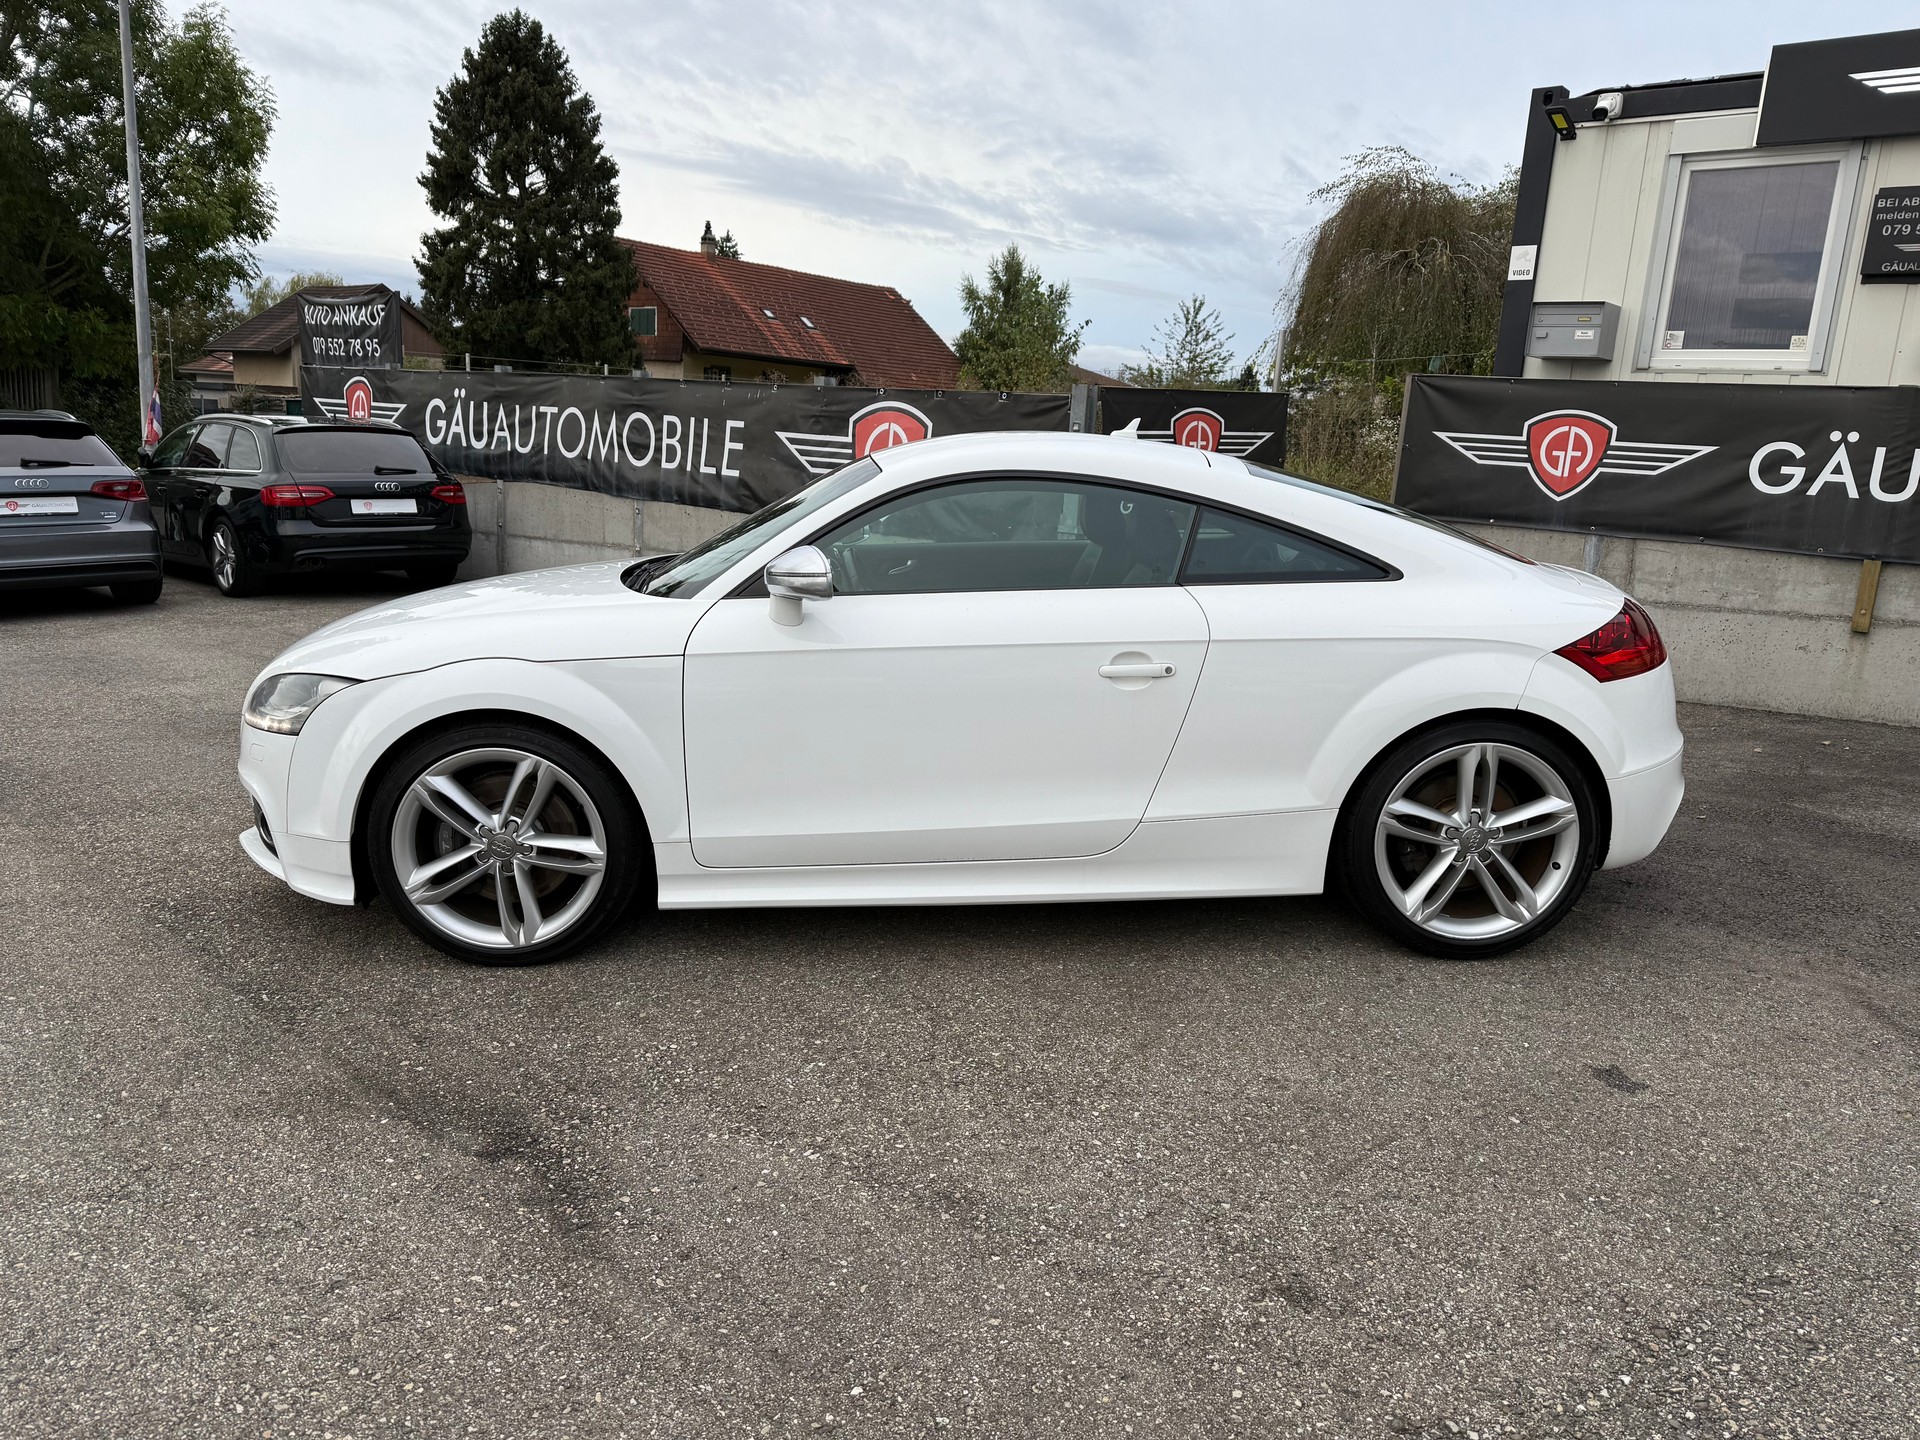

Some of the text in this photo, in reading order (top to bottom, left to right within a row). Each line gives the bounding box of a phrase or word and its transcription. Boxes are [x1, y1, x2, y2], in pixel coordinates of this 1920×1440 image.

[1877, 197, 1920, 207] BEI AB
[1876, 210, 1919, 220] melden
[1882, 224, 1911, 236] 079
[304, 304, 386, 326] AUTO ANKAUF
[312, 336, 380, 357] 079 552 78 95
[425, 388, 745, 477] GÄUAUTOMOBILE
[1540, 425, 1594, 477] GA
[1748, 430, 1920, 502] GÄU
